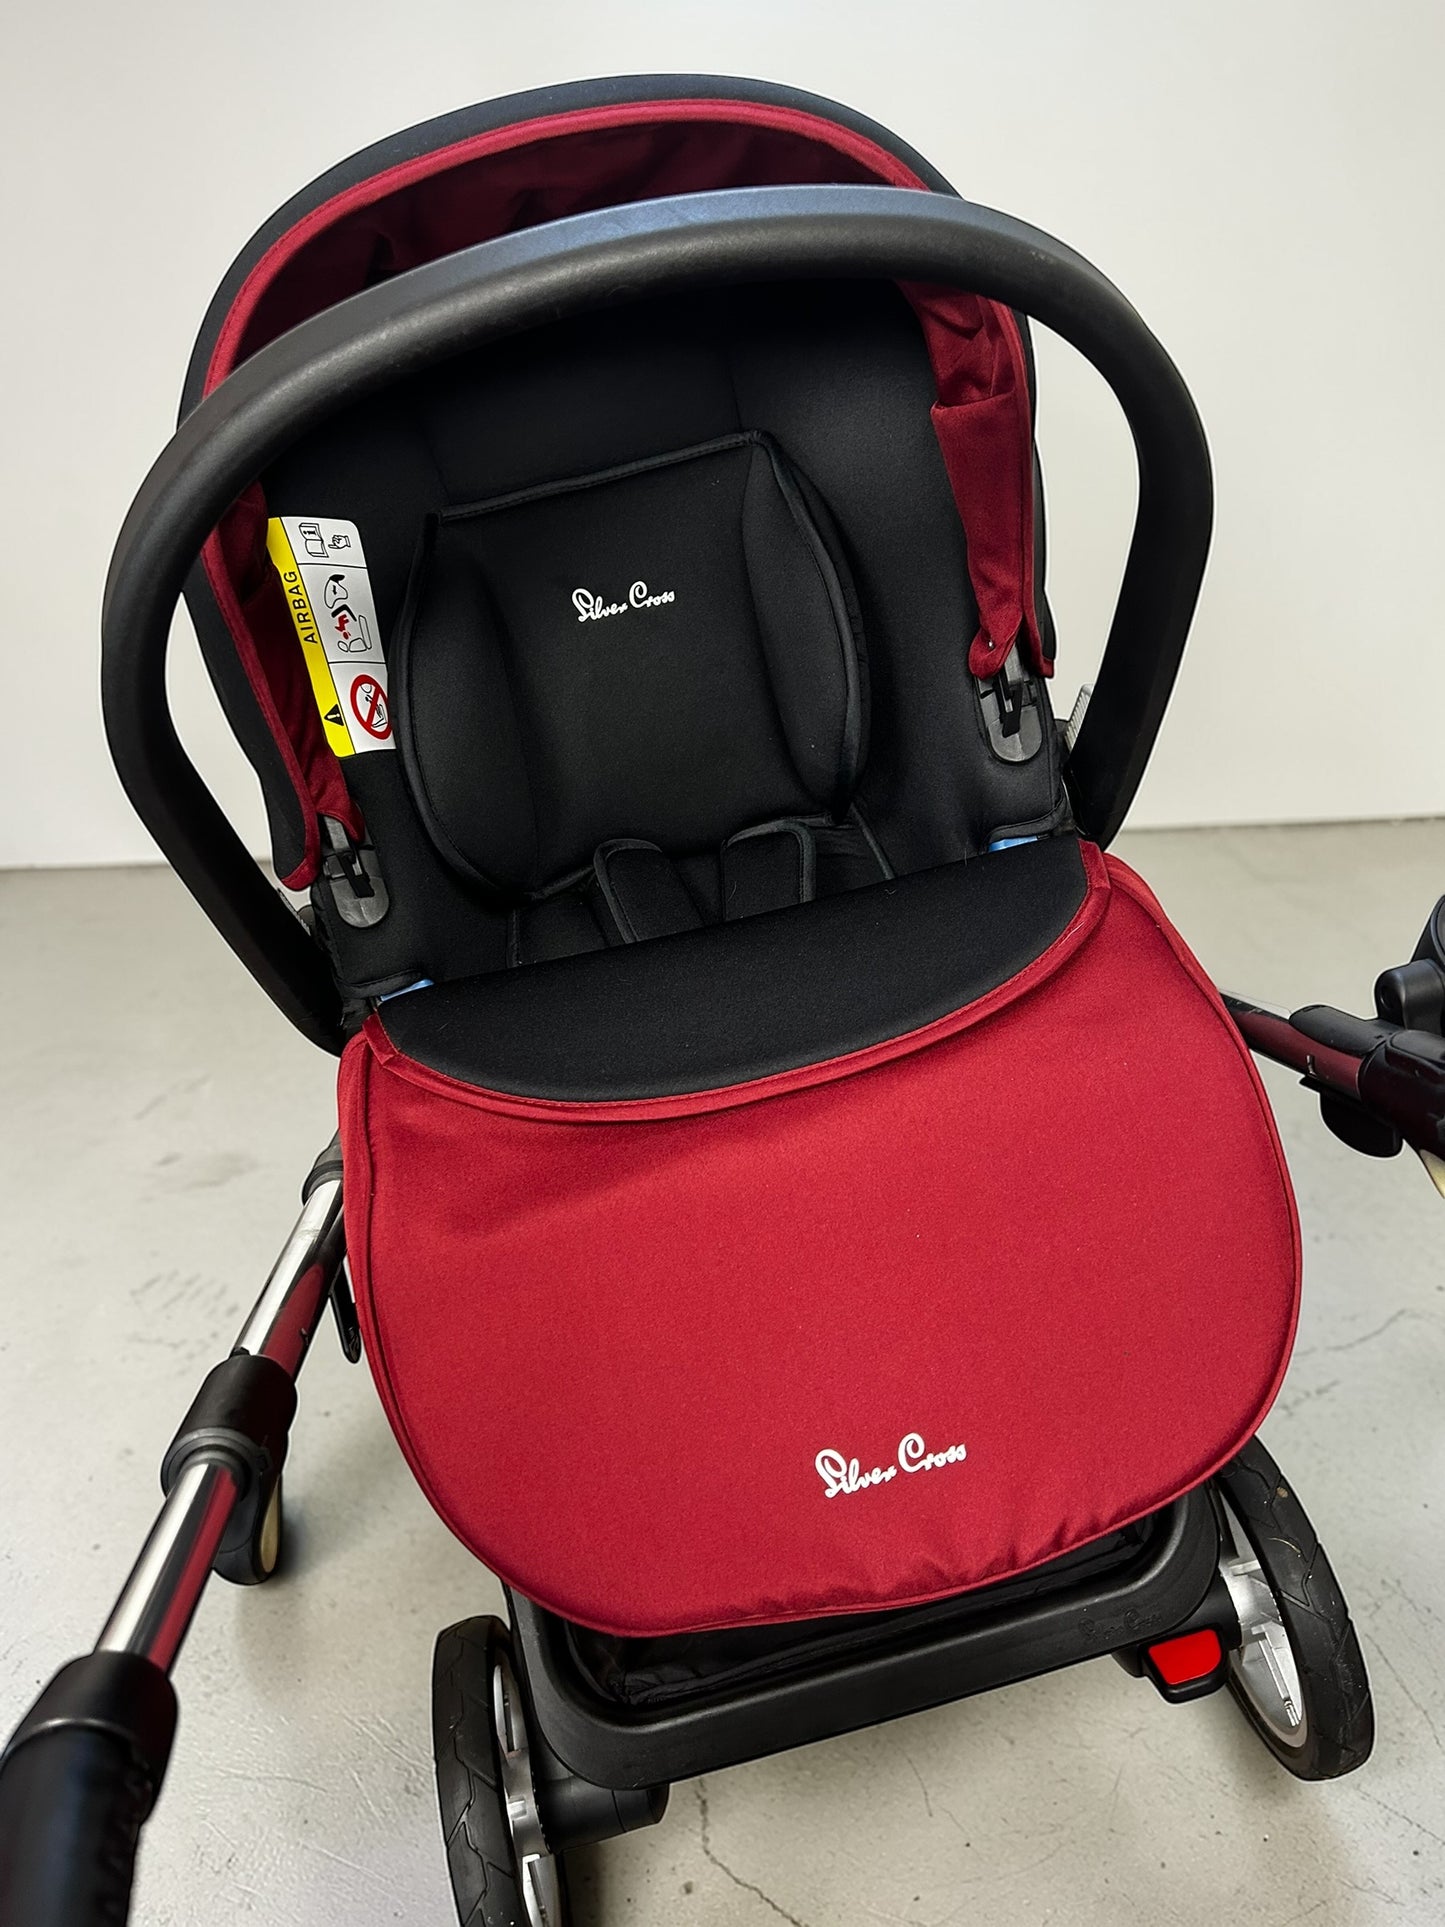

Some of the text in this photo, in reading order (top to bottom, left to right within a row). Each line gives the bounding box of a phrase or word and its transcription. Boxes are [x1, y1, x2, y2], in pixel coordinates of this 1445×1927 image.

[283, 571, 318, 644] AIRBAG
[571, 581, 675, 622] Silver Cross
[814, 1433, 967, 1498] Silver Cross
